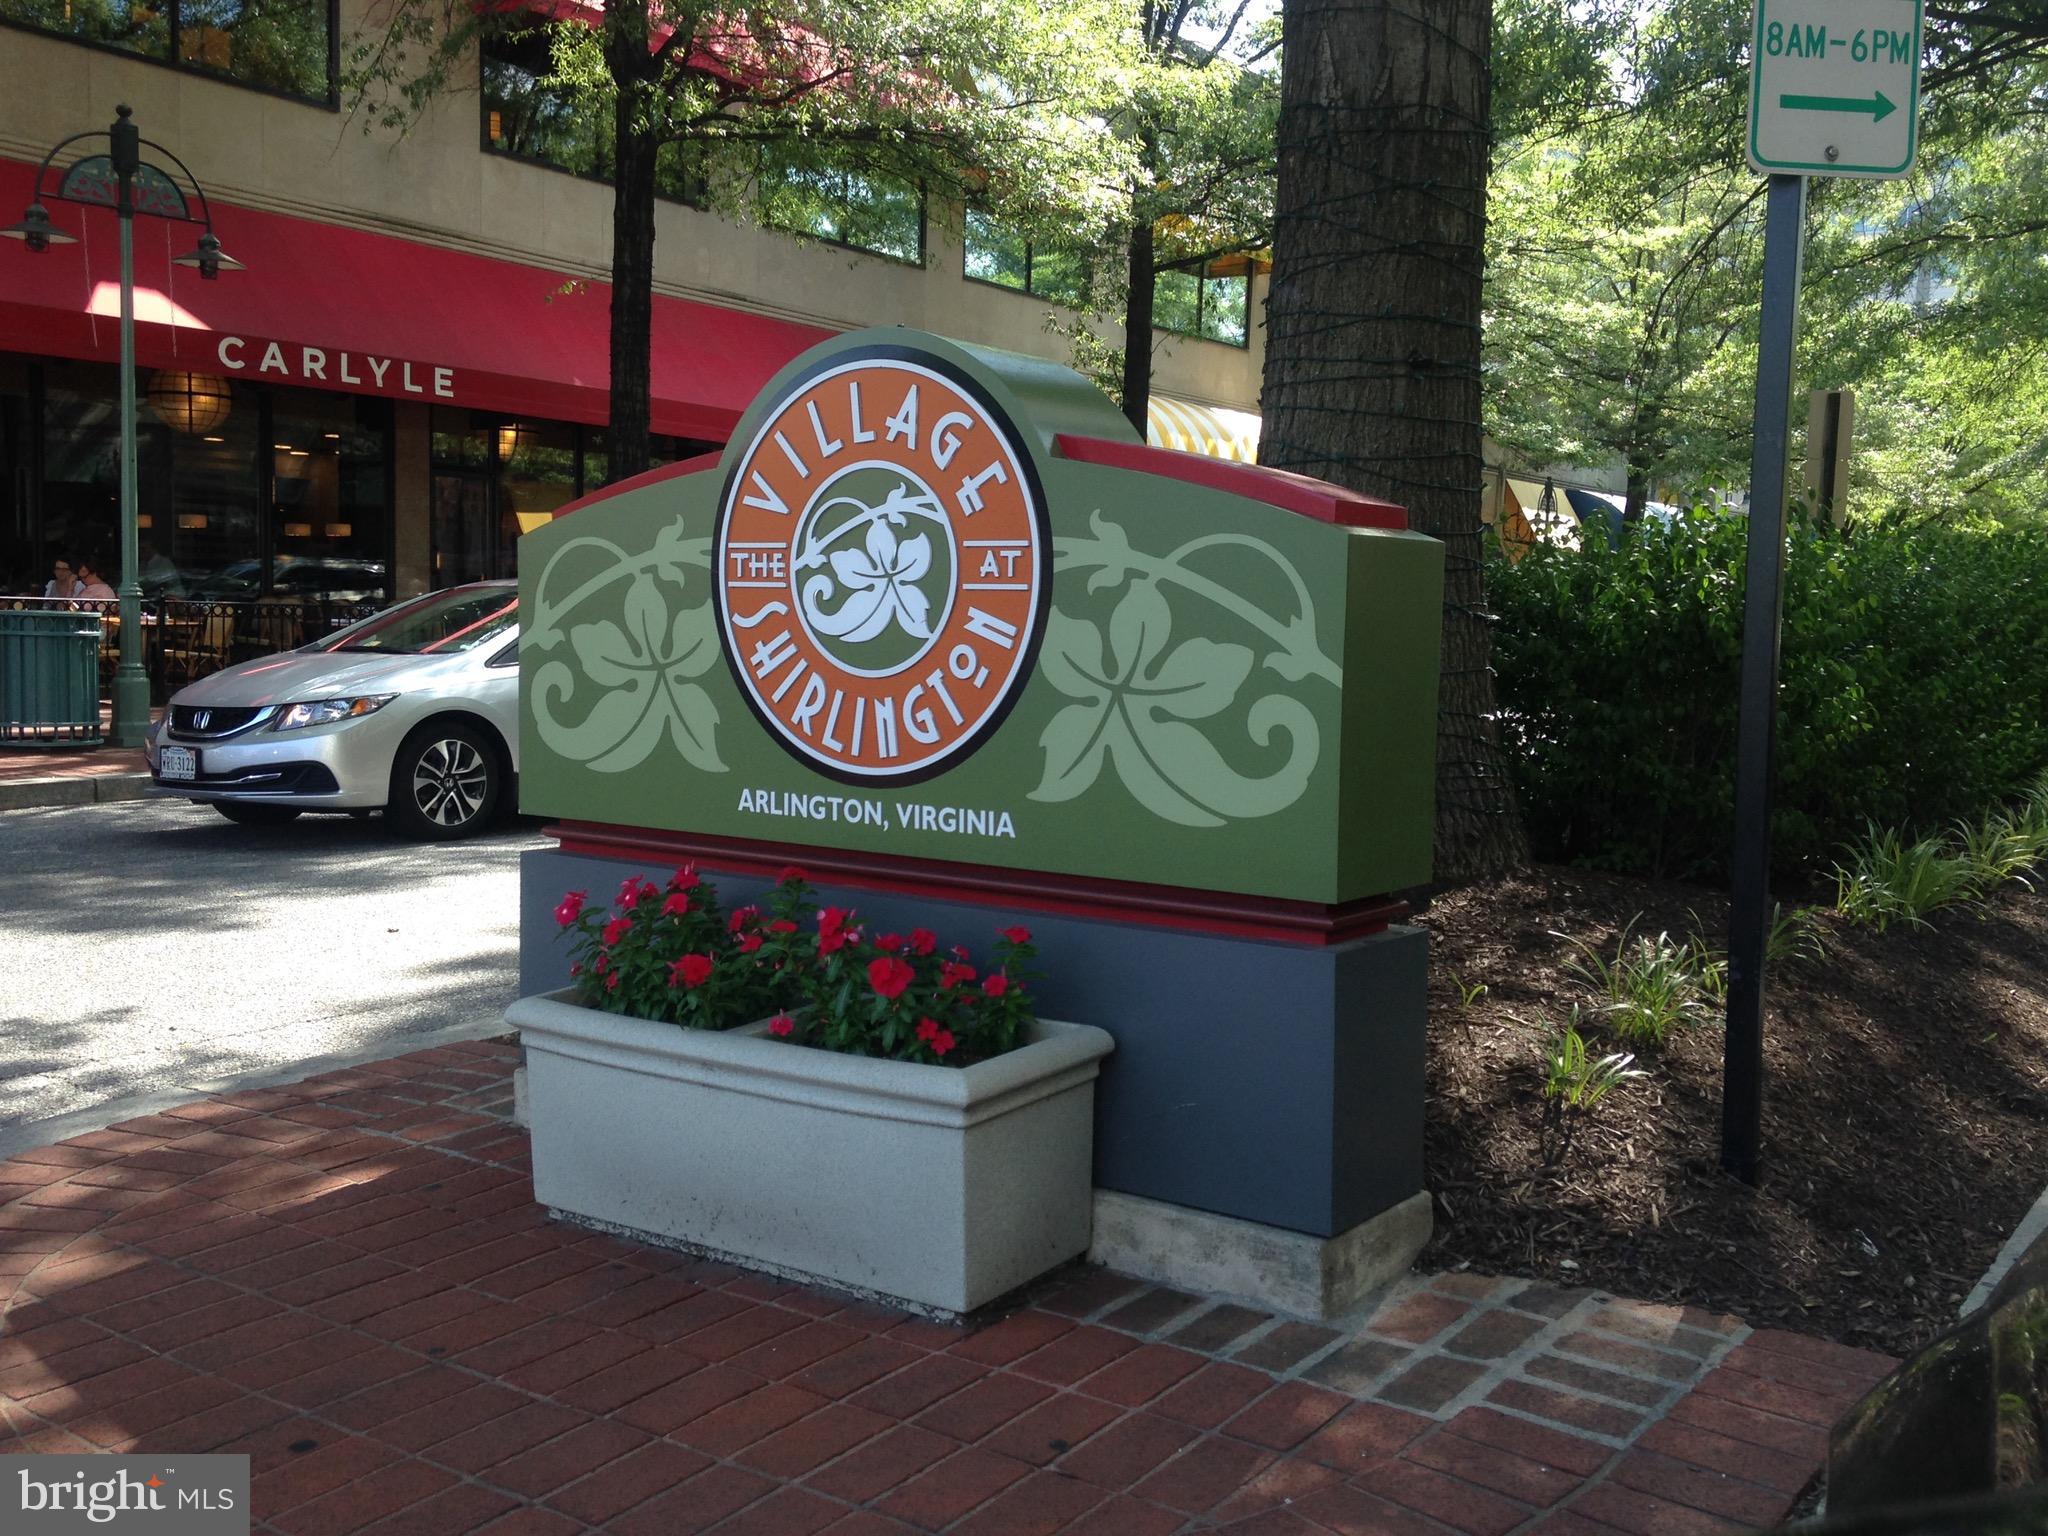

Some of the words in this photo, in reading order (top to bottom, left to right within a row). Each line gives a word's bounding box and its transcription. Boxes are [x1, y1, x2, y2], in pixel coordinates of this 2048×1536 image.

[1766, 21, 1910, 64] 8AM-6PM
[218, 336, 455, 398] CARLYLE
[743, 381, 1007, 516] VILLAGE
[731, 552, 786, 578] THE
[979, 550, 1021, 577] AT
[731, 601, 1018, 758] SHIRLINGTON
[738, 788, 889, 831] ARLINGTON,
[896, 804, 1016, 838] VIRGINIA
